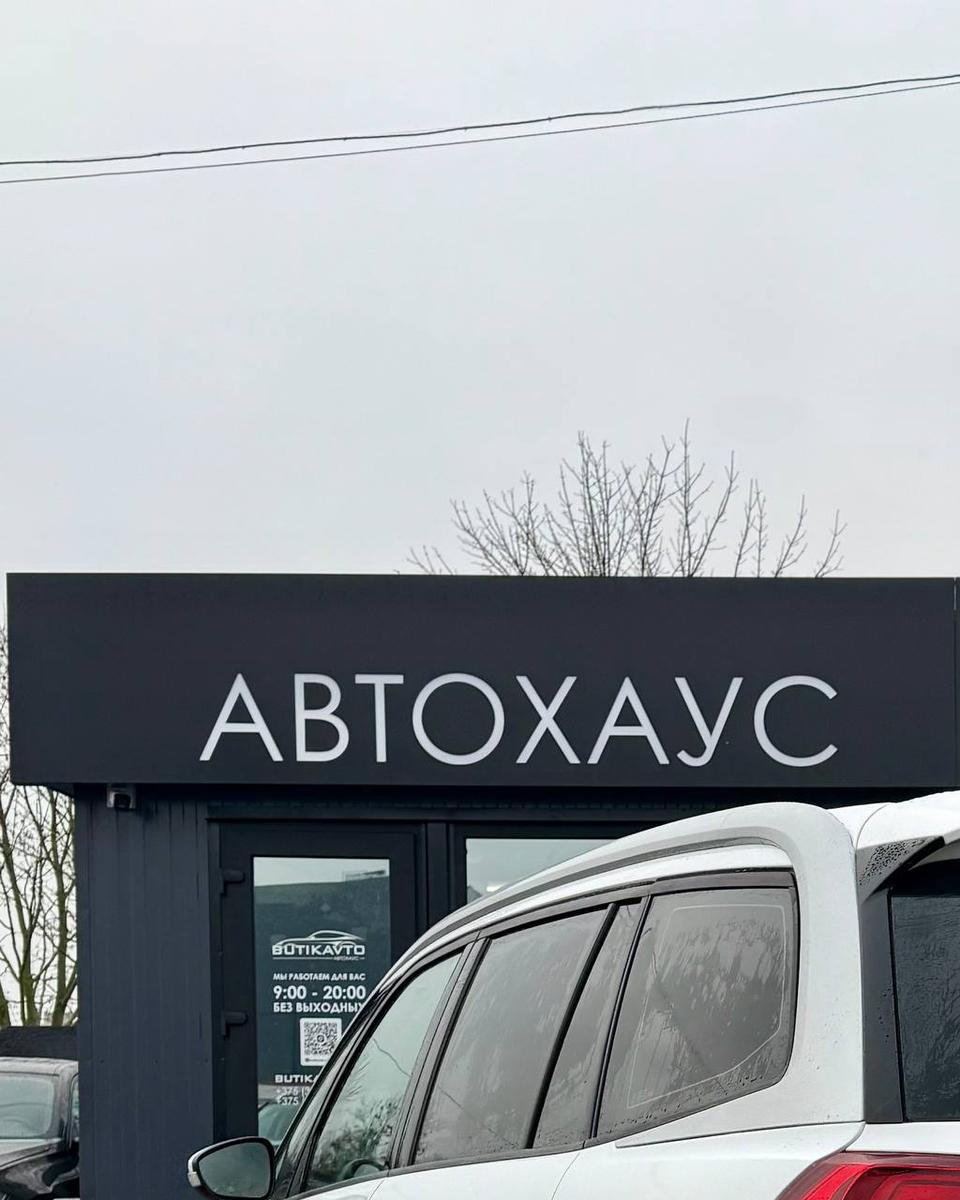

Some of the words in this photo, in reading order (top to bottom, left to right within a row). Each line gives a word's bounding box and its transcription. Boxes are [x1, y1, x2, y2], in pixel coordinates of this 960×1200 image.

[200, 673, 838, 767] АВТОХАУС
[272, 944, 366, 956] BUTIKAVTO
[273, 972, 288, 981] МЫ
[288, 972, 330, 981] РАБОТАЕМ
[330, 972, 348, 982] ДЛЯ
[349, 972, 366, 981] ВАС
[273, 985, 307, 1000] 9:00
[323, 985, 366, 1000] 20:00
[273, 1002, 293, 1013] БЕЗ
